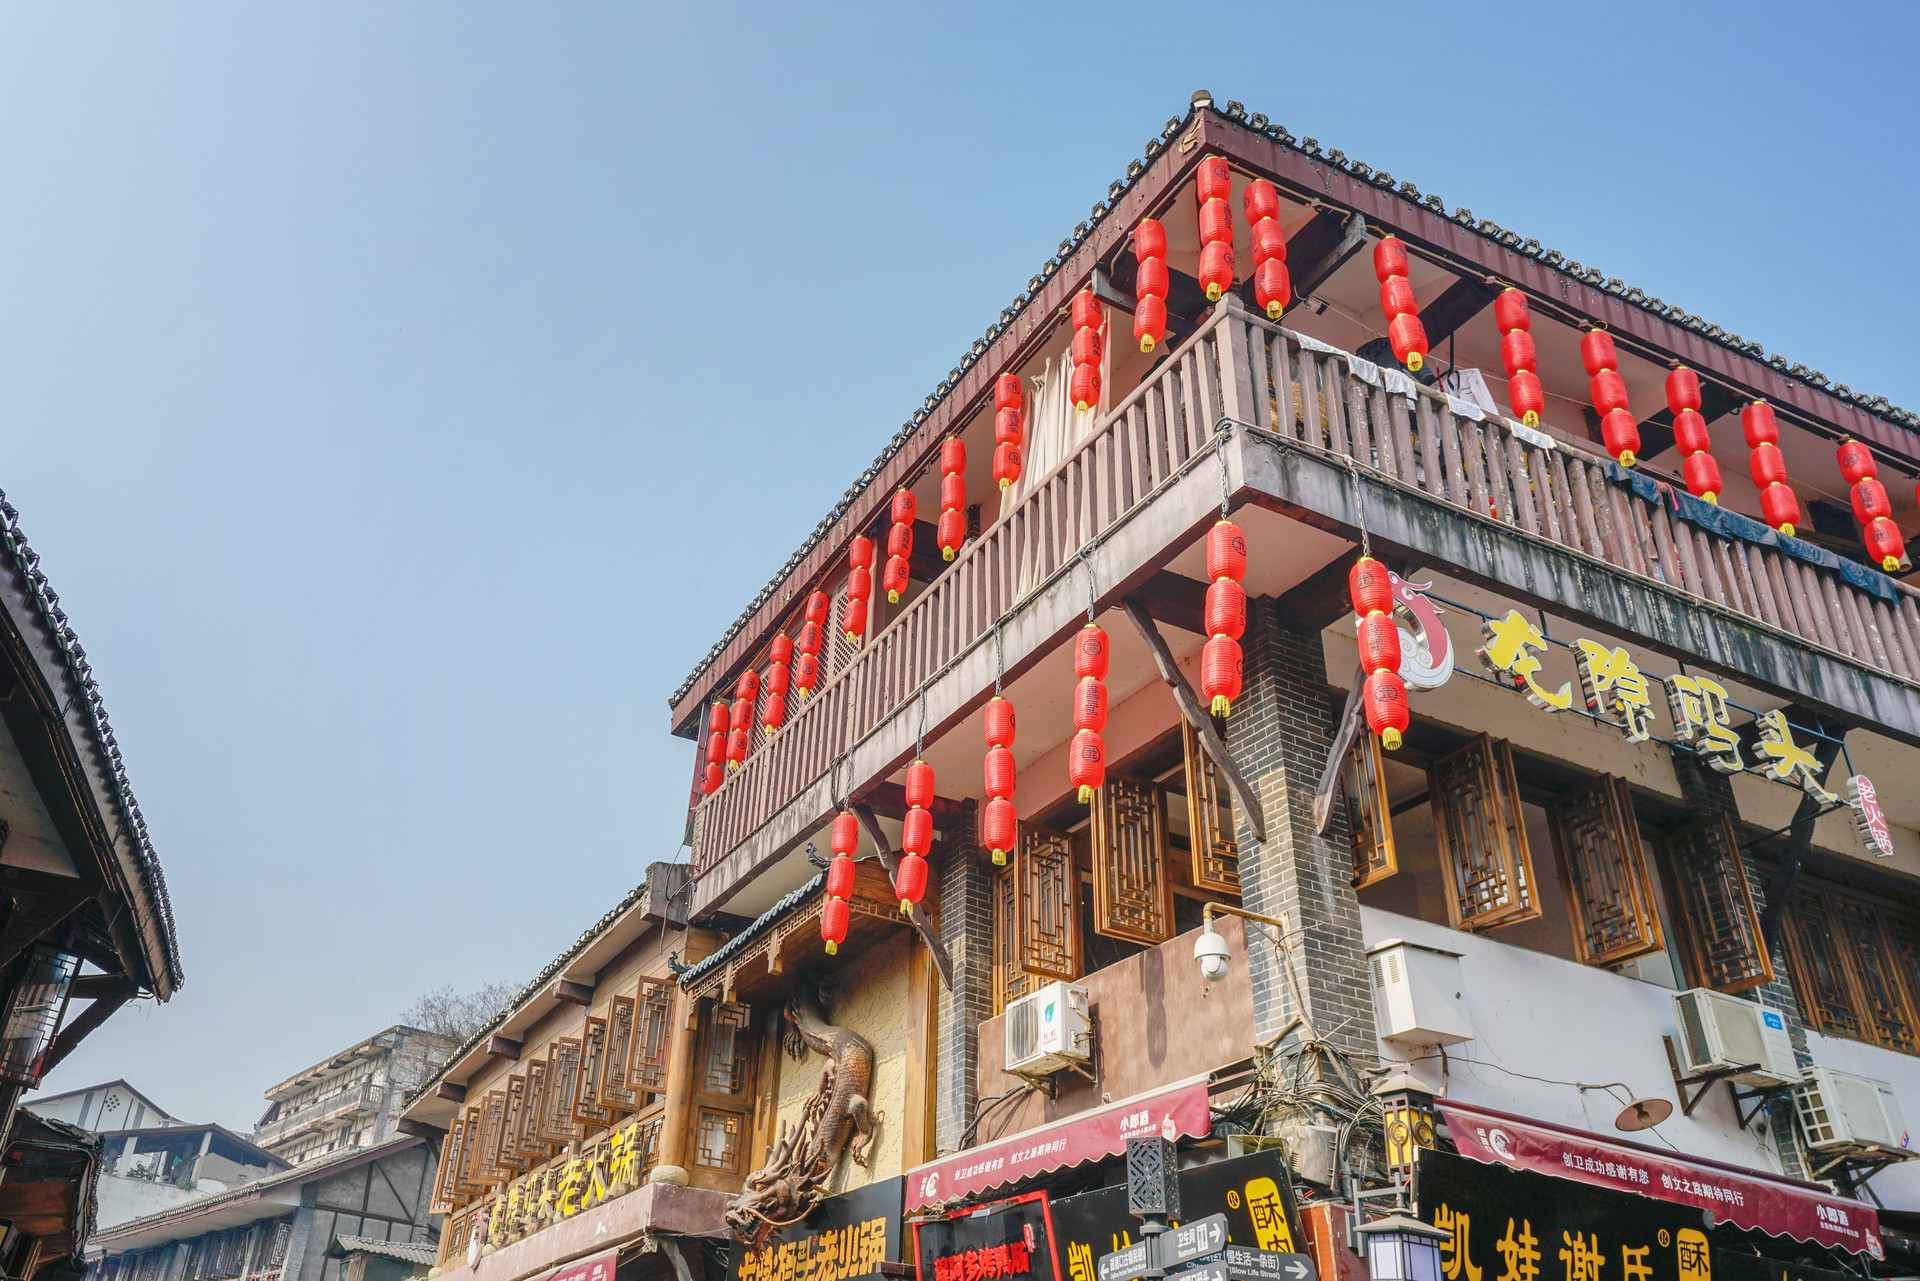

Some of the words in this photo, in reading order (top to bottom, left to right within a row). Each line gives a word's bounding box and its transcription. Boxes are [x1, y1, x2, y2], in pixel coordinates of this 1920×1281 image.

[1120, 1110, 1149, 1131] 小郎酒
[954, 1157, 1005, 1181] 创卫成功感谢有您
[1010, 1138, 1067, 1165] 创文之路期待同行
[1562, 1152, 1649, 1185] 创卫成功感谢有您
[1661, 1173, 1744, 1207] 创文之路期待同行
[1816, 1204, 1849, 1226] 小郎酒
[1178, 1229, 1195, 1248] 卫生间
[1229, 1266, 1246, 1275] (Slow
[1247, 1268, 1259, 1277] Life
[1260, 1270, 1280, 1280] Street)
